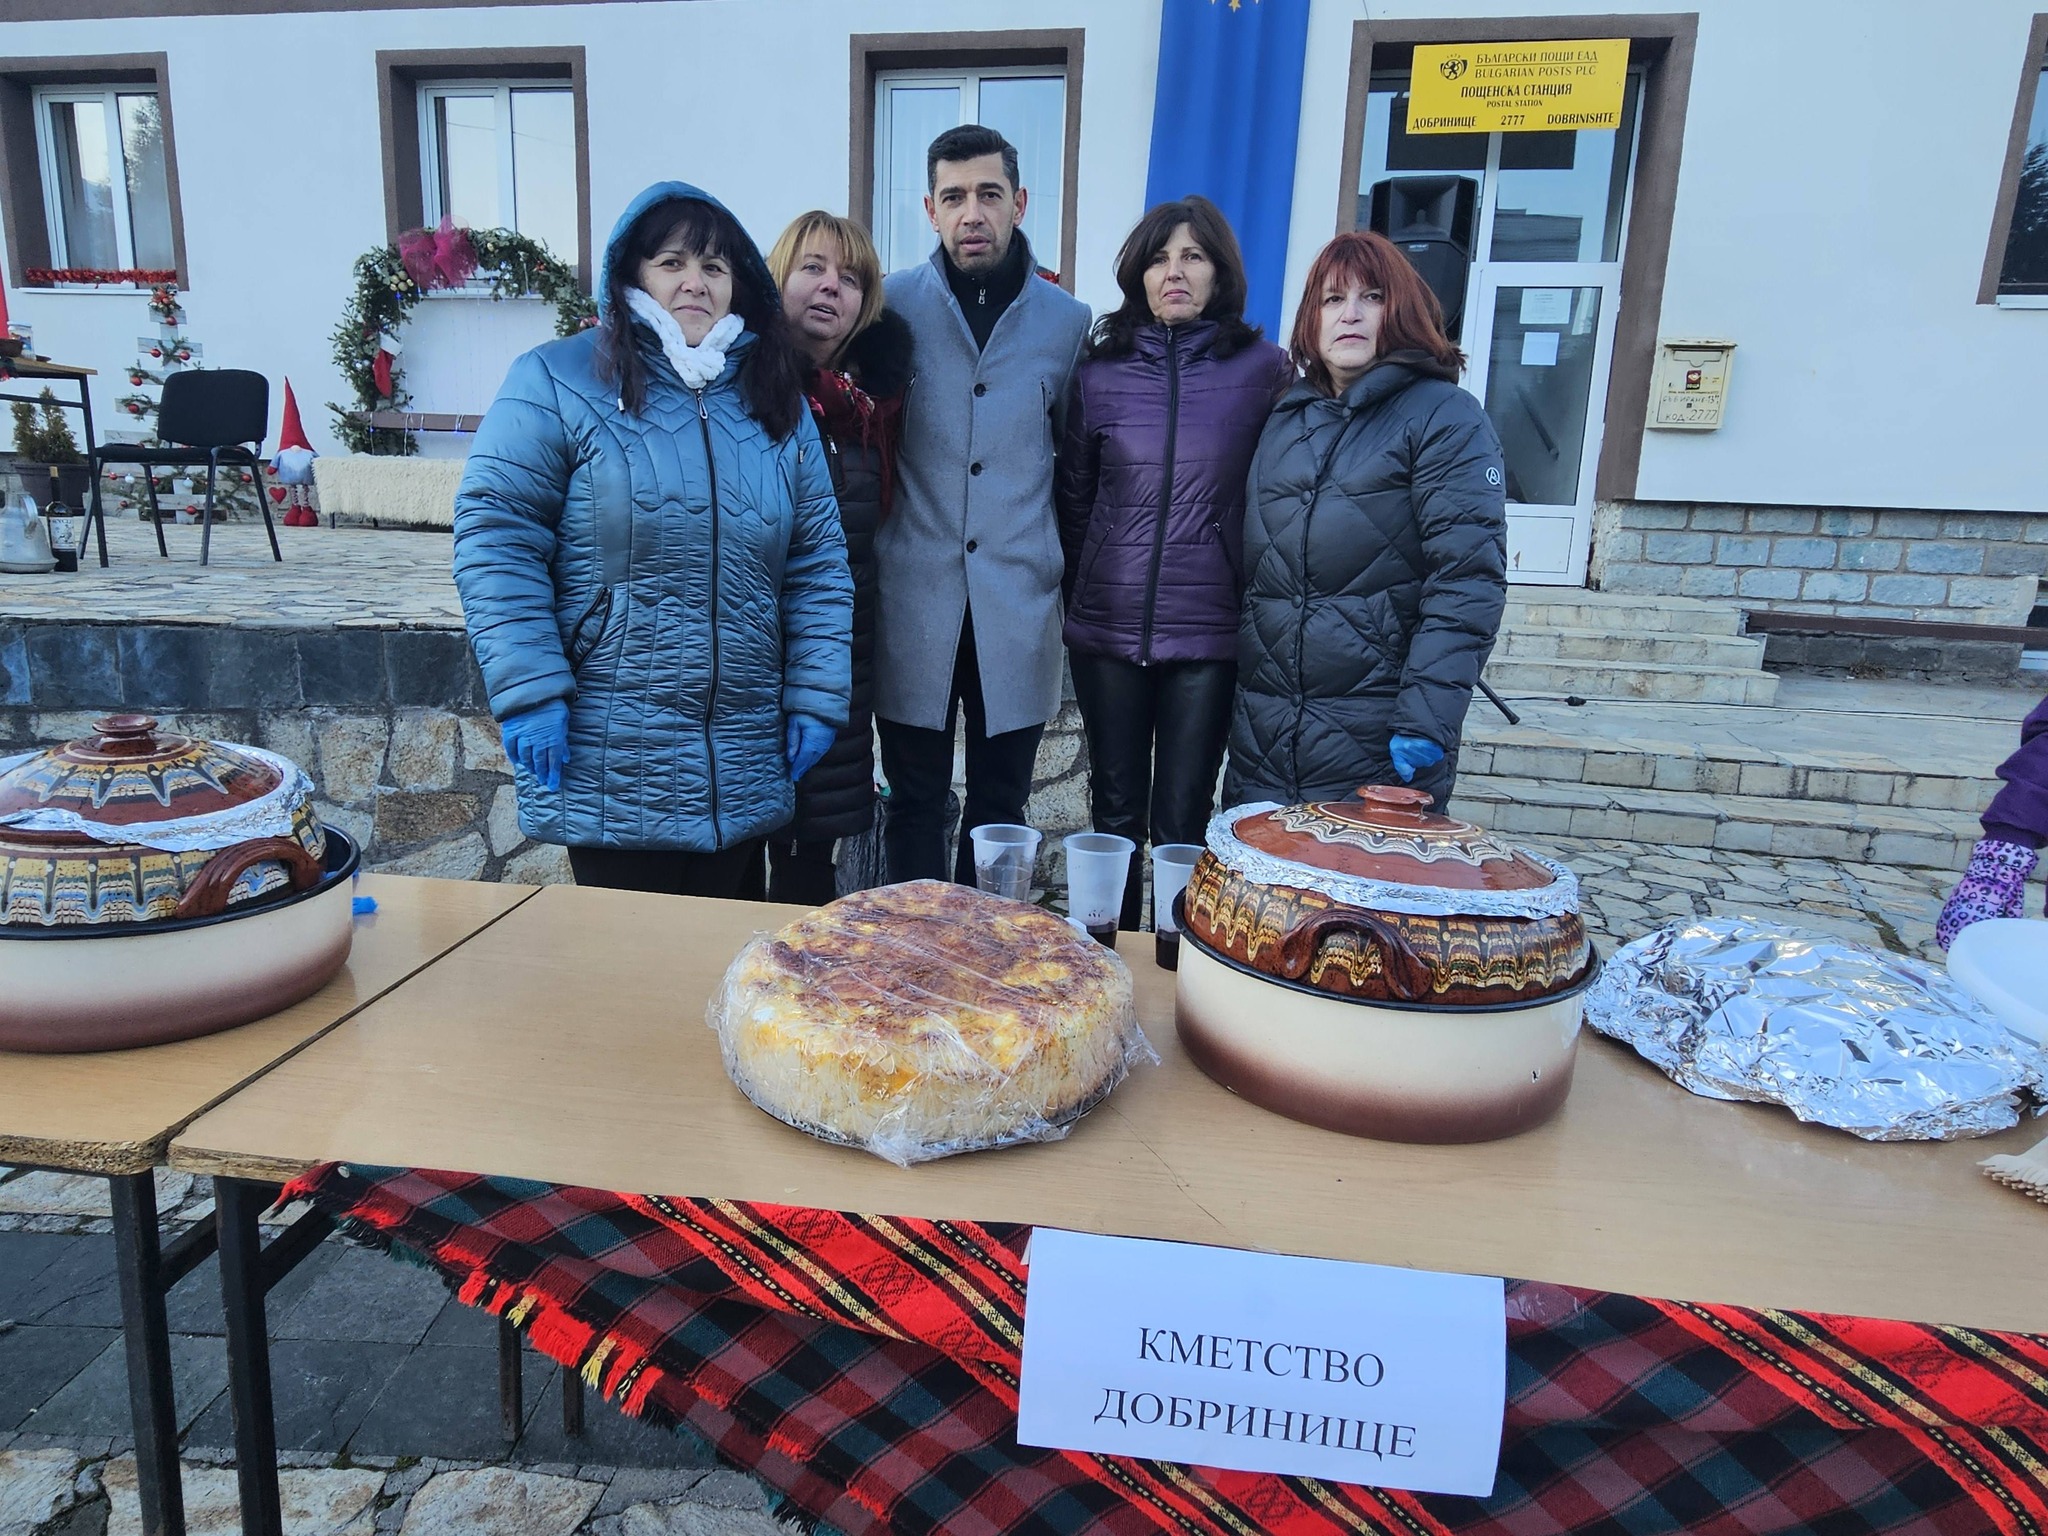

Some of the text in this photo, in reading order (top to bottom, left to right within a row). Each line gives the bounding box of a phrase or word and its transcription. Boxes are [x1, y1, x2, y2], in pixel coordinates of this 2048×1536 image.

[1476, 50, 1598, 64] БЪЛГАРСКИ ПОЩИ ЕАД
[1475, 65, 1597, 79] BULGARIAN POSTS PLC
[1460, 83, 1572, 98] ПОЩЕНСКА СТАНЦИЯ
[1486, 99, 1543, 108] POSTAL STATION
[1412, 112, 1614, 130] ДОБРИНИЩЕ 2777 DOBRINISHTE
[1137, 1326, 1386, 1388] КМЕТСТВО
[1093, 1386, 1418, 1462] ДОБРИНИЩЕ
